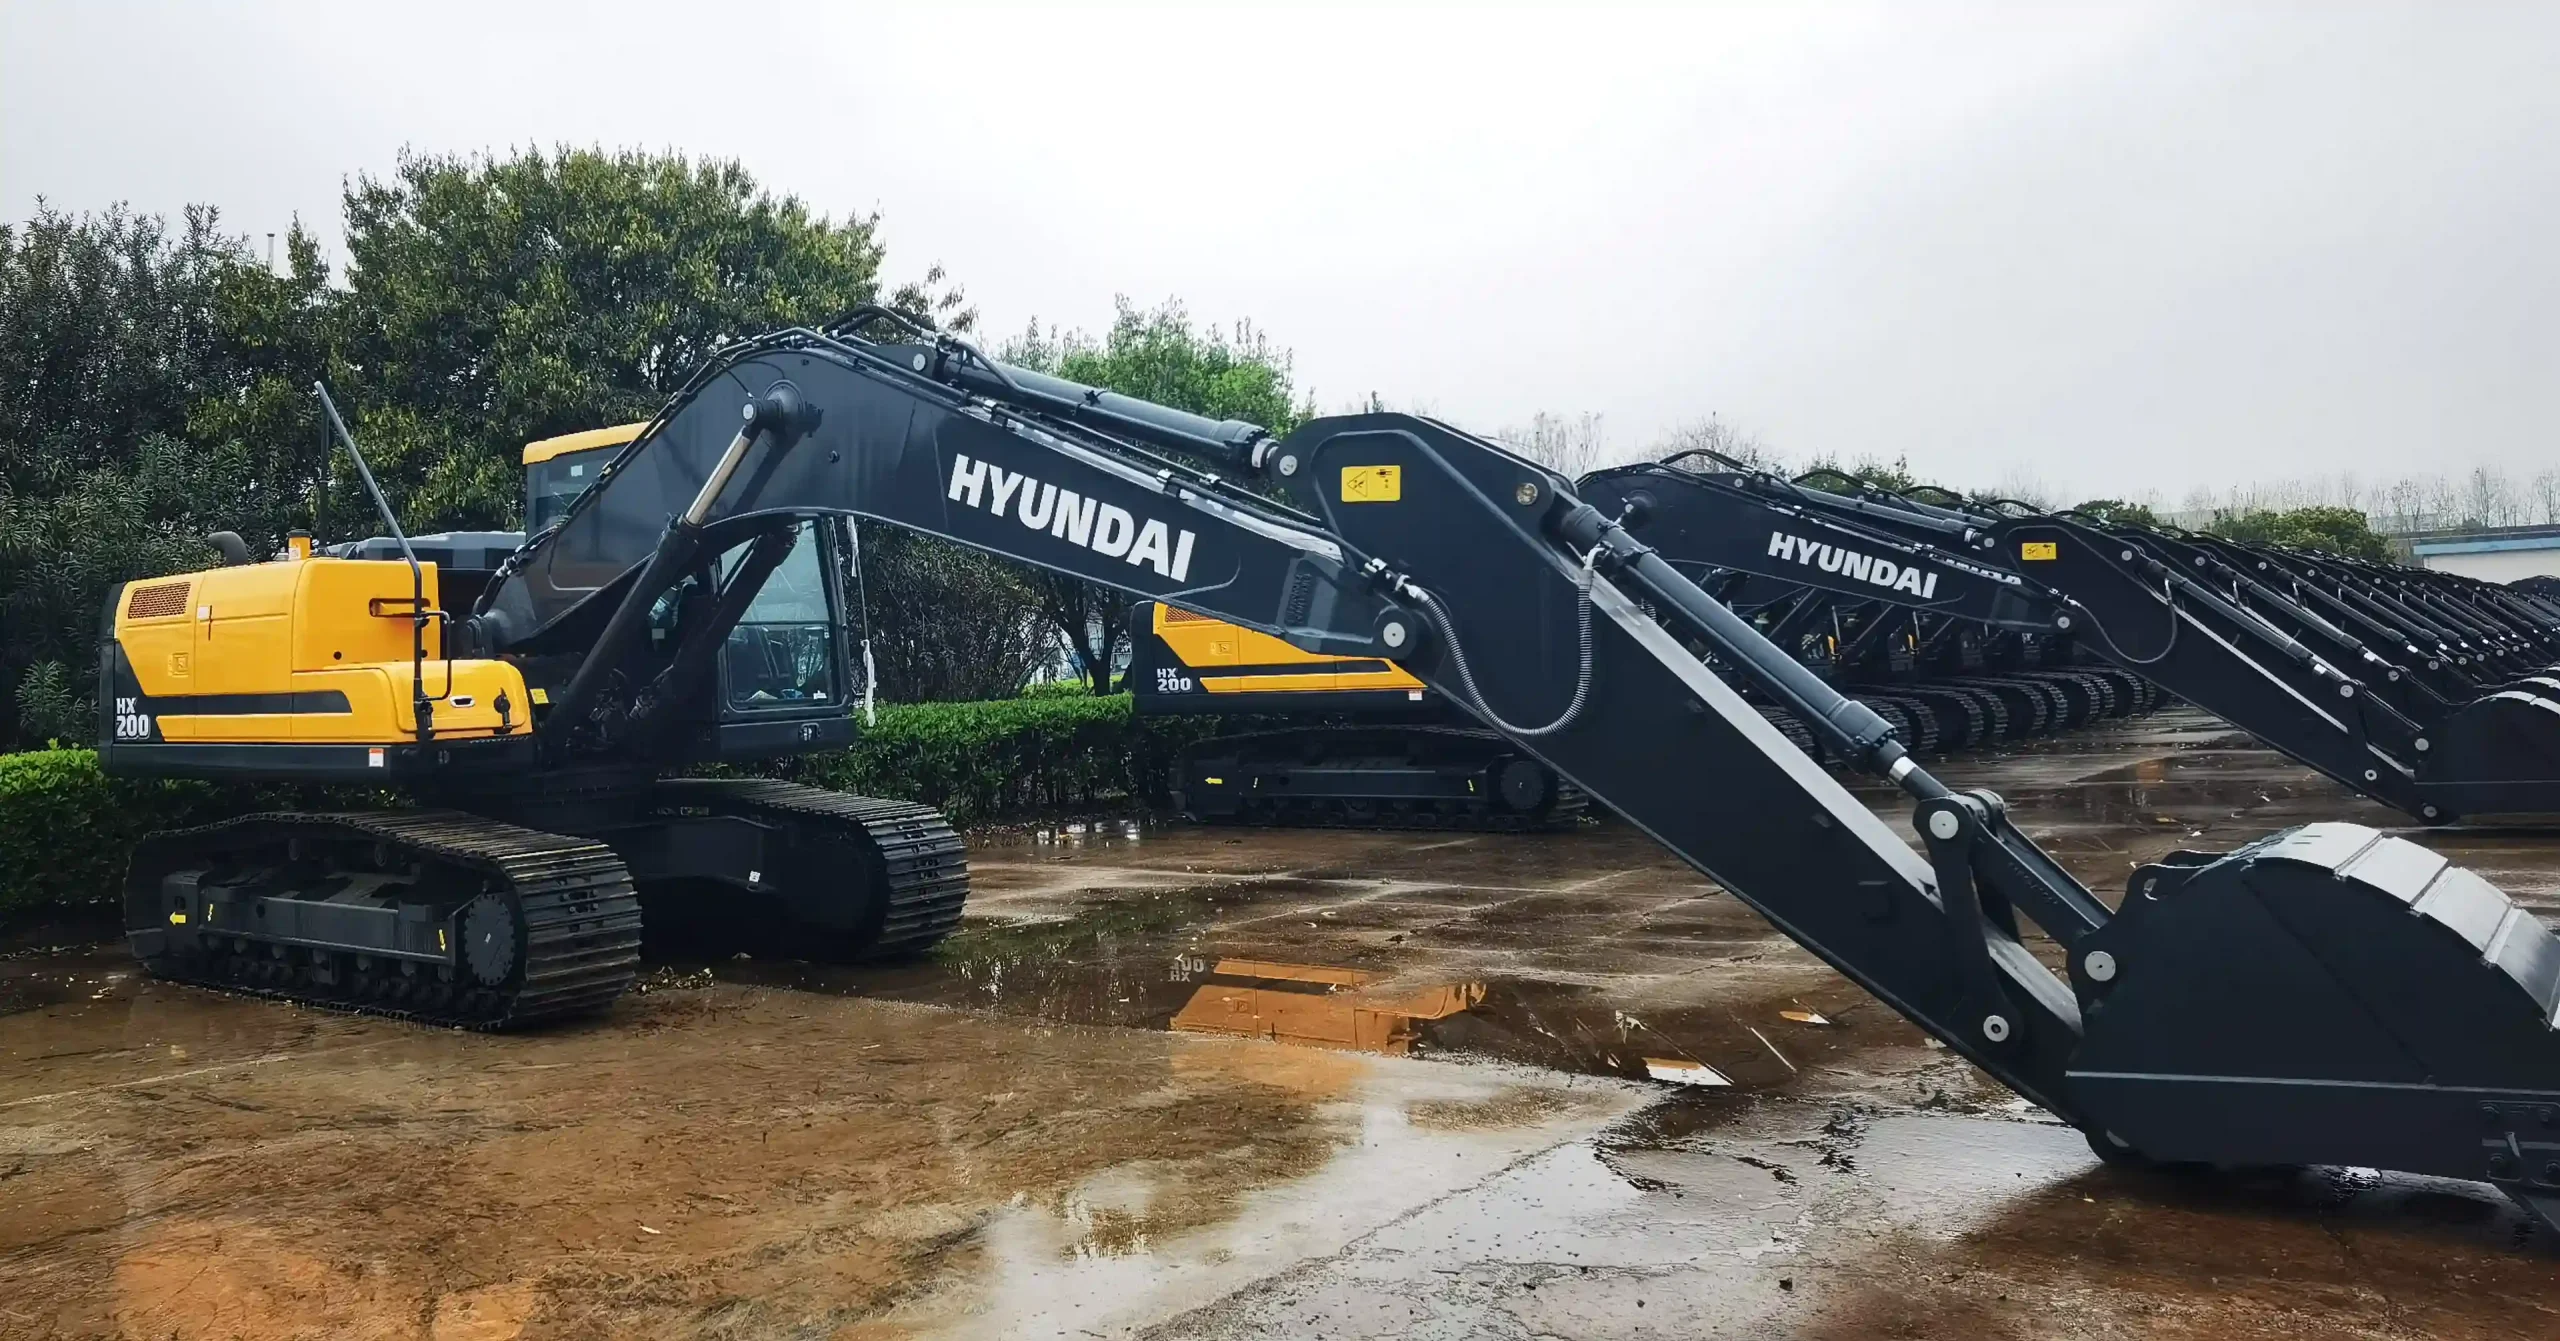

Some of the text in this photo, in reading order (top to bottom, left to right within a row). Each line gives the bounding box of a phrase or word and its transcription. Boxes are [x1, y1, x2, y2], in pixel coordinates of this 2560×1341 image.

[948, 453, 1196, 583] HYUNDAI
[1768, 531, 1938, 599] HYUNDAI
[1157, 667, 1177, 678] HX
[1157, 677, 1191, 693] 200
[116, 697, 137, 714] HX
[116, 714, 151, 739] 200
